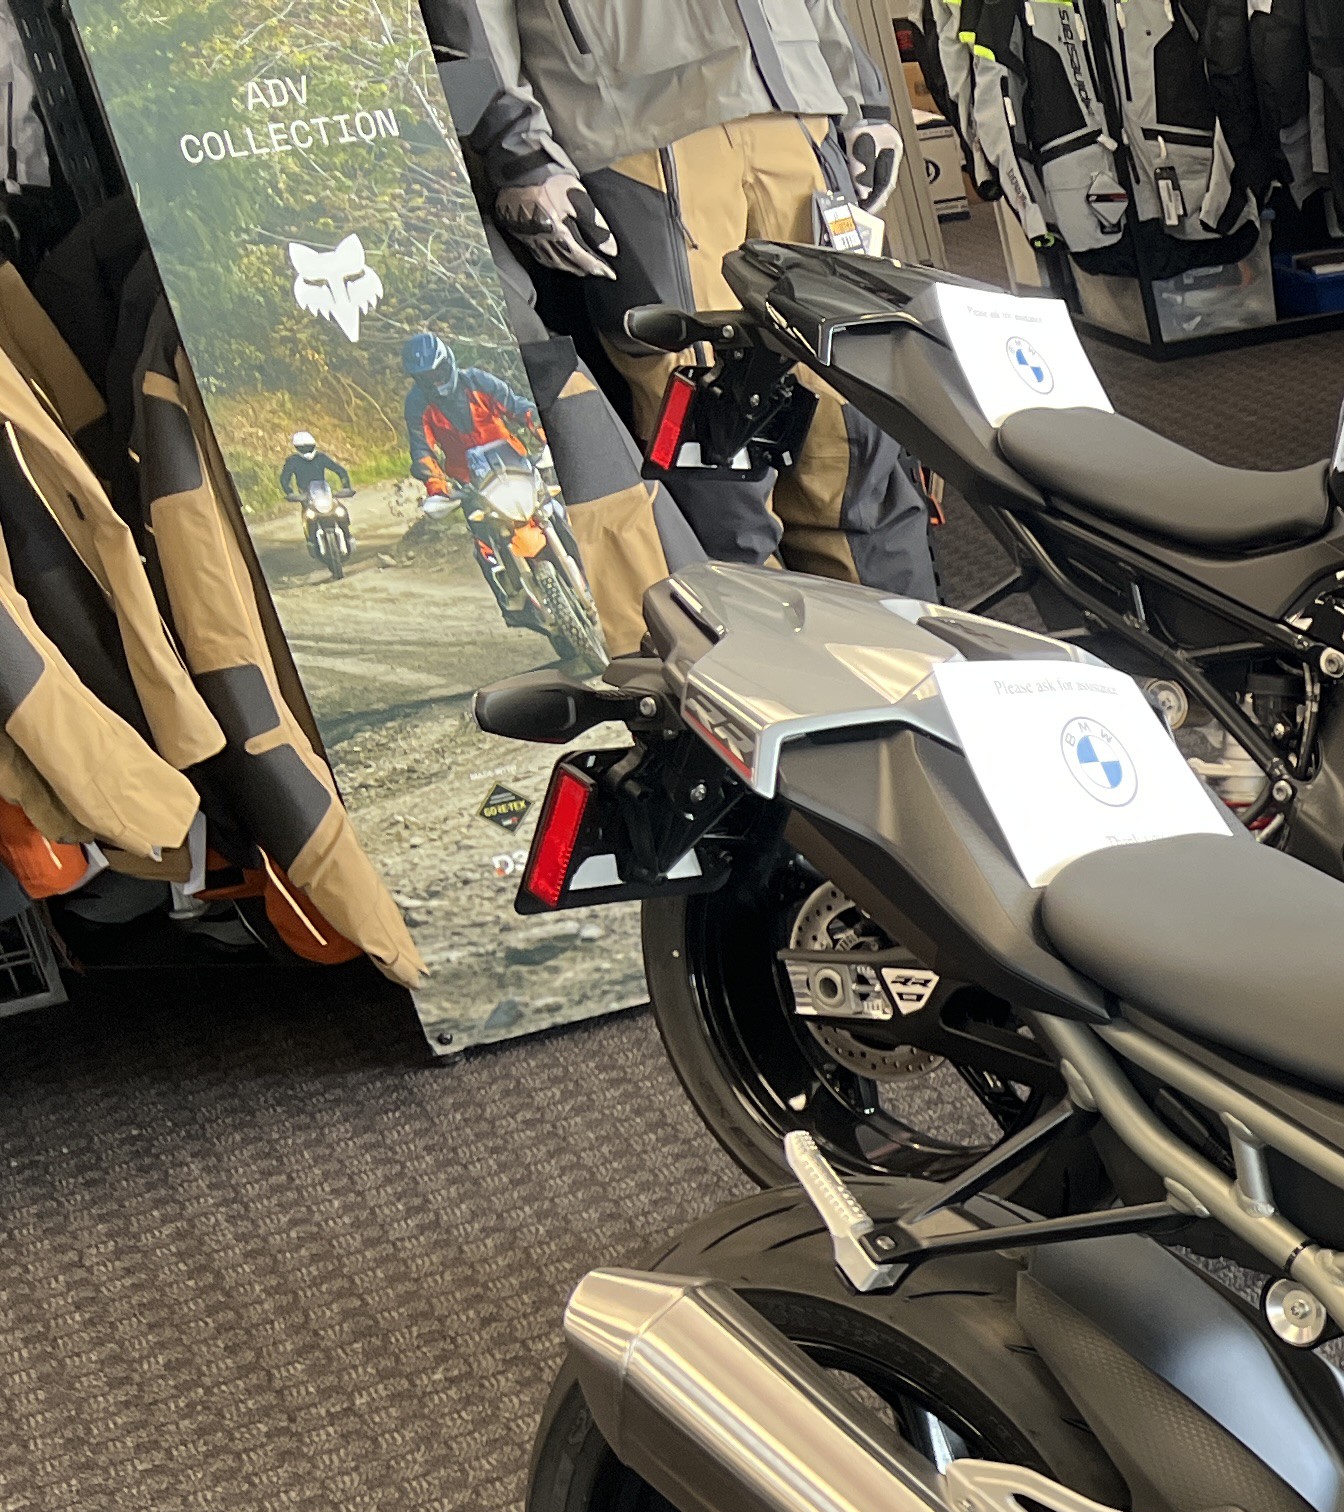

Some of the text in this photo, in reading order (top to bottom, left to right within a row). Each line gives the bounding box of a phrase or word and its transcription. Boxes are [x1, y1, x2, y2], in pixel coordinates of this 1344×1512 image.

[246, 74, 308, 111] ADV
[179, 107, 400, 165] COLLECTION
[993, 679, 1034, 695] Please
[1035, 677, 1057, 693] ask
[1064, 720, 1114, 748] BMW
